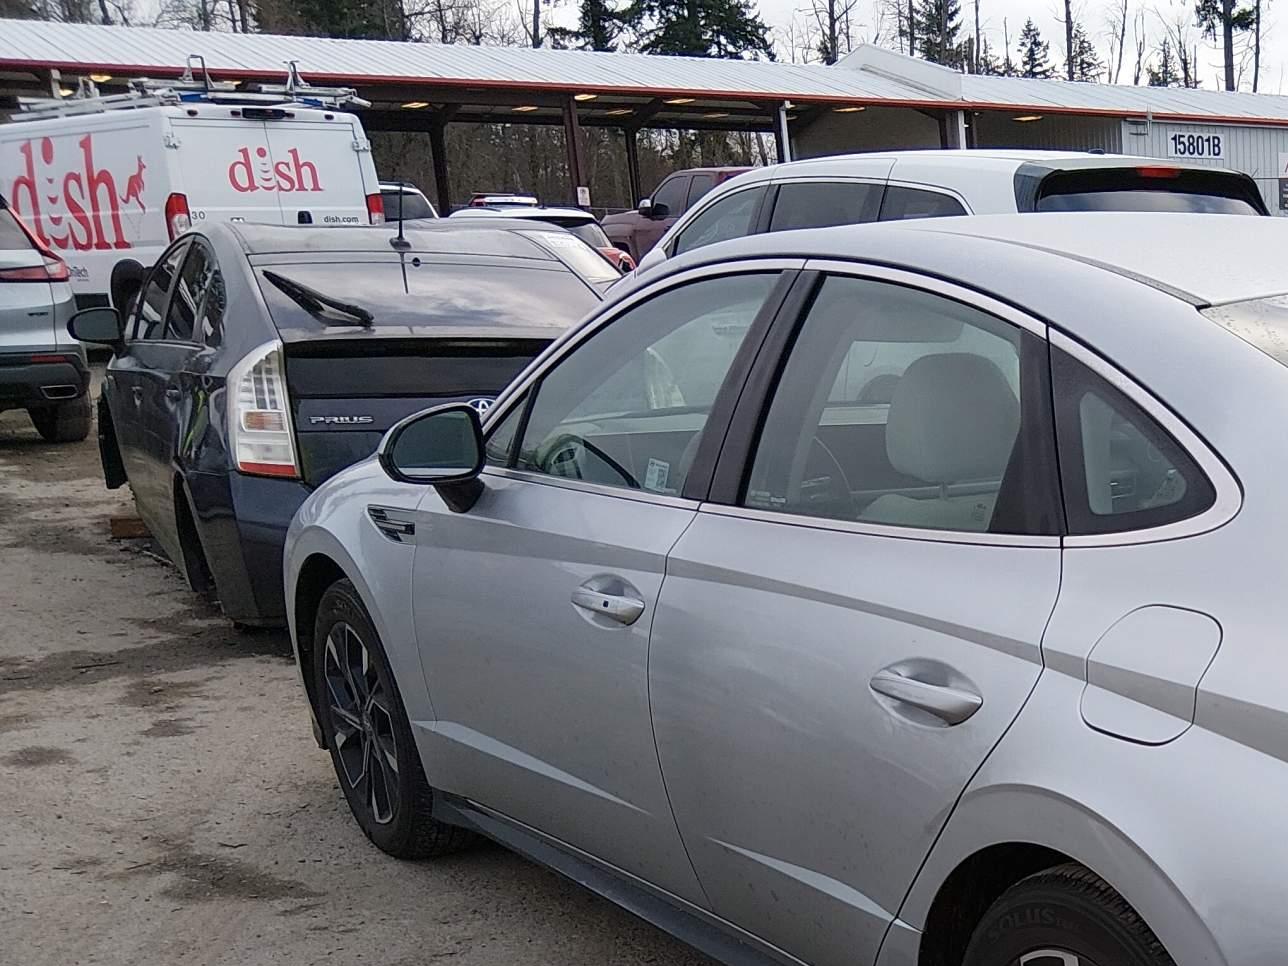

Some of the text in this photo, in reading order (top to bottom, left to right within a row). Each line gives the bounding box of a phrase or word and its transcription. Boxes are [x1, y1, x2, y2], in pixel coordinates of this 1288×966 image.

[1171, 133, 1221, 156] 15801B
[228, 147, 324, 193] dish
[11, 134, 132, 251] dish
[323, 215, 359, 223] dish.com
[310, 416, 374, 424] PRIUS
